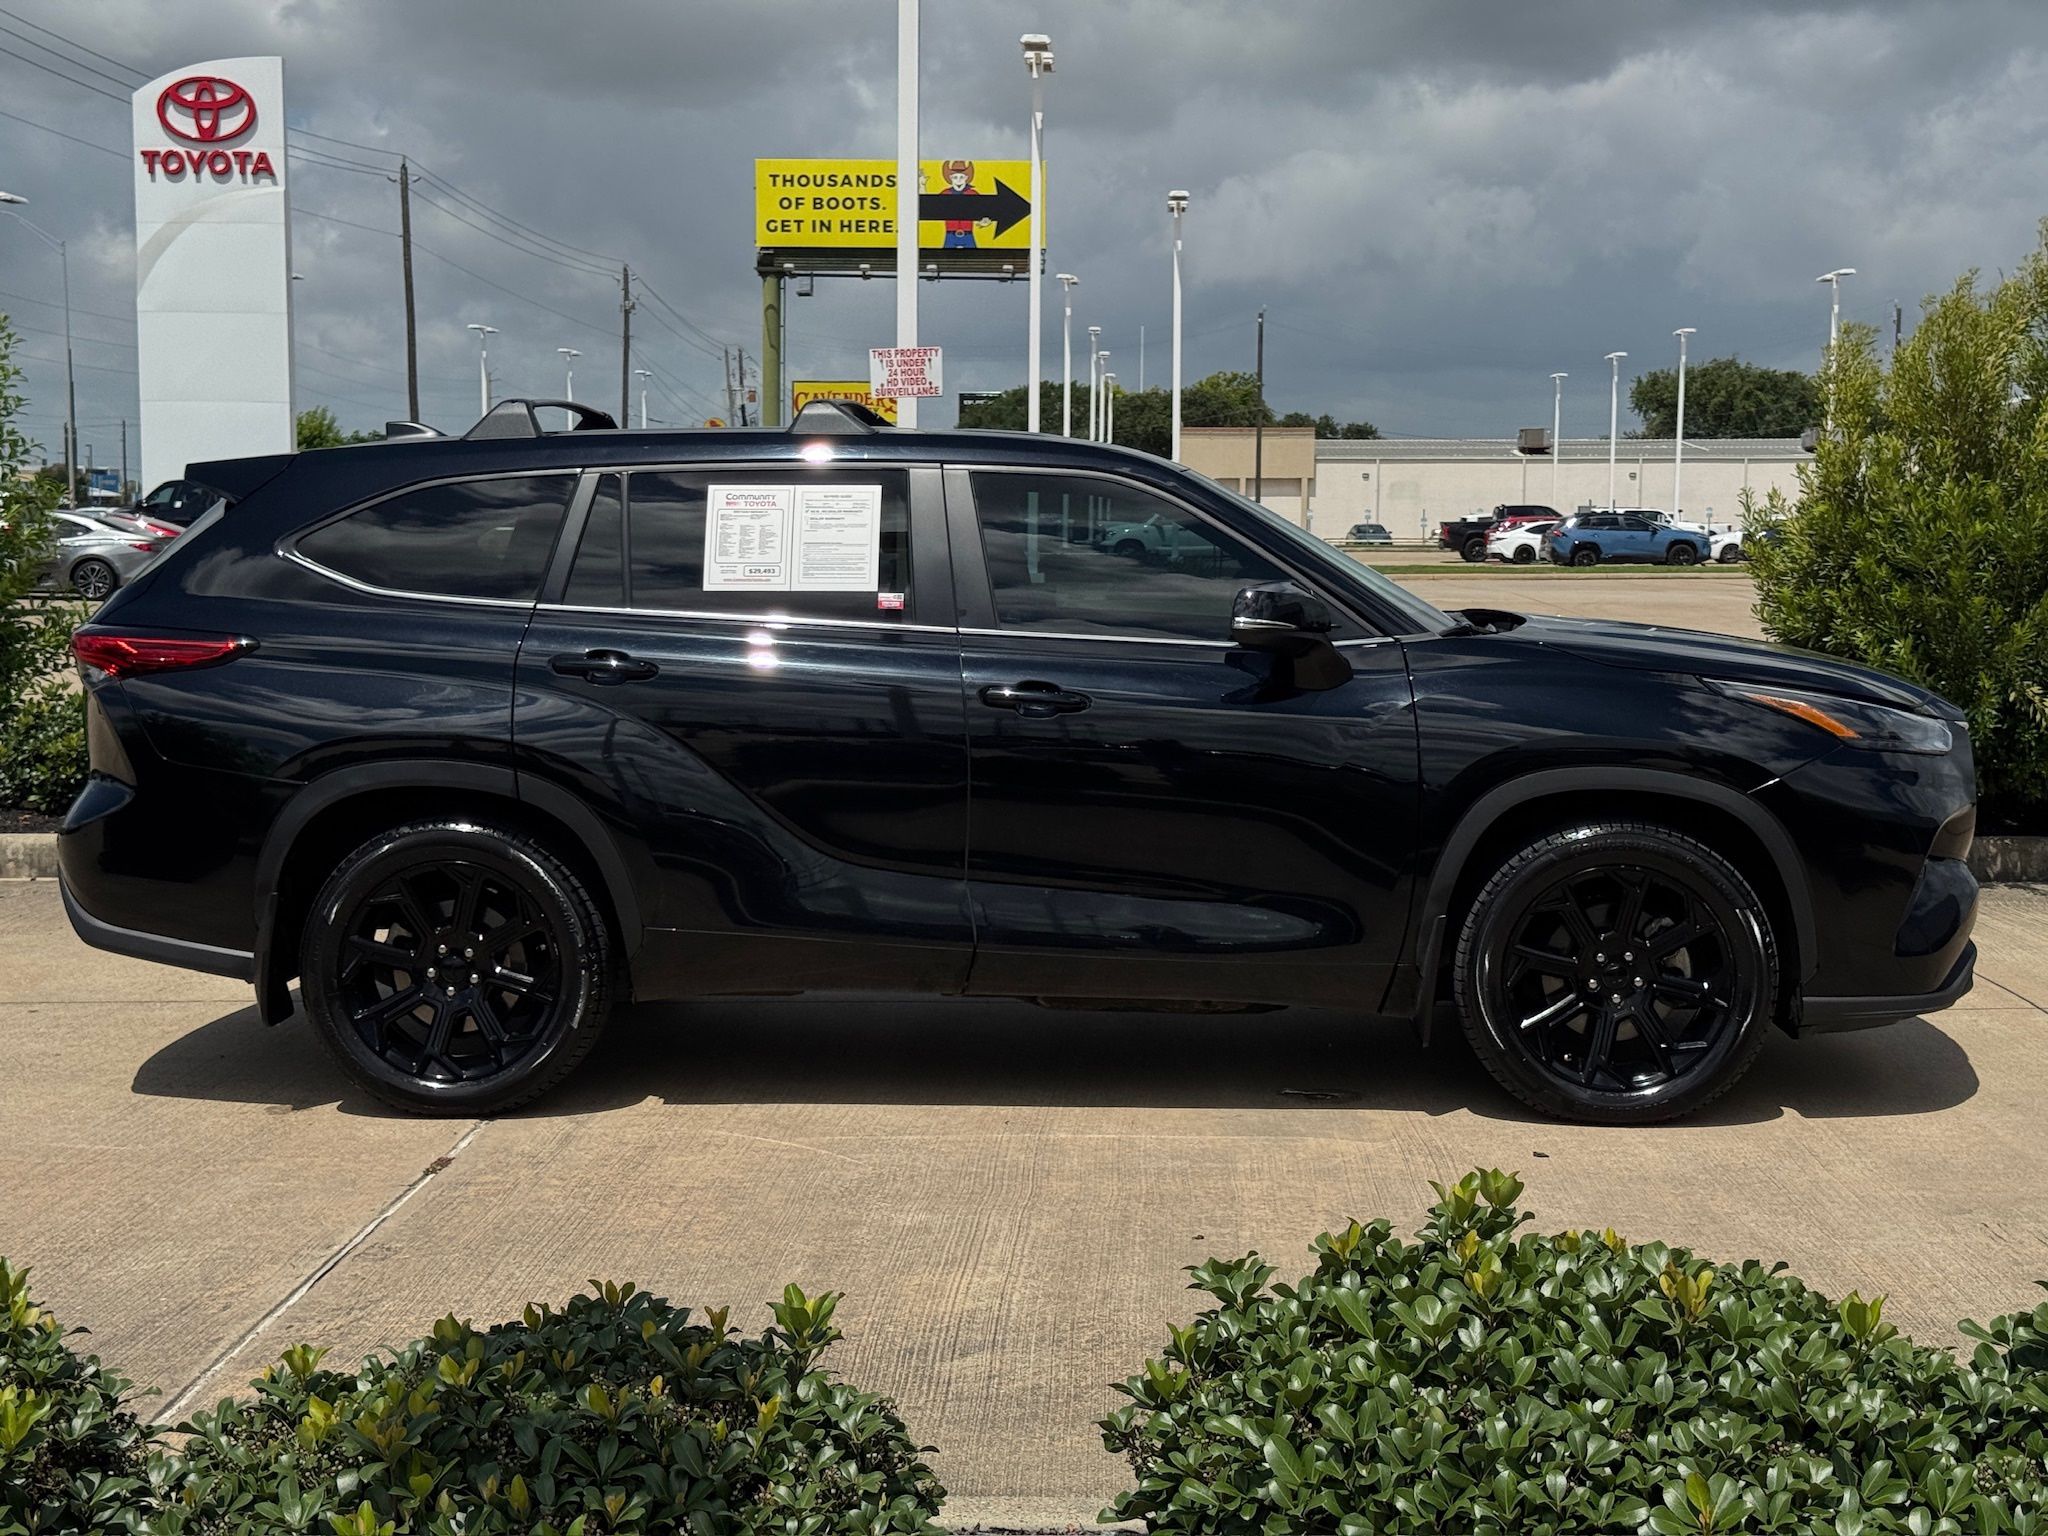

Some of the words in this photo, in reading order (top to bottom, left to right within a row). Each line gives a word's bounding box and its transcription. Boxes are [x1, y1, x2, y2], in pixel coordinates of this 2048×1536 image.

[140, 150, 275, 177] TOYOTA
[769, 174, 897, 188] THOUSANDS
[779, 197, 805, 210] OF
[812, 197, 886, 210] BOOTS.
[766, 219, 804, 233] GET
[811, 220, 832, 233] IN
[872, 349, 892, 359] THIS
[894, 348, 939, 358] PROPERTY
[885, 359, 894, 368] IS
[896, 358, 926, 368] UNDER
[888, 368, 898, 377] 24
[900, 368, 925, 377] HOUR
[887, 378, 899, 387] HD
[900, 377, 927, 386] VIDEO
[875, 386, 940, 397] SURVEILLANCE
